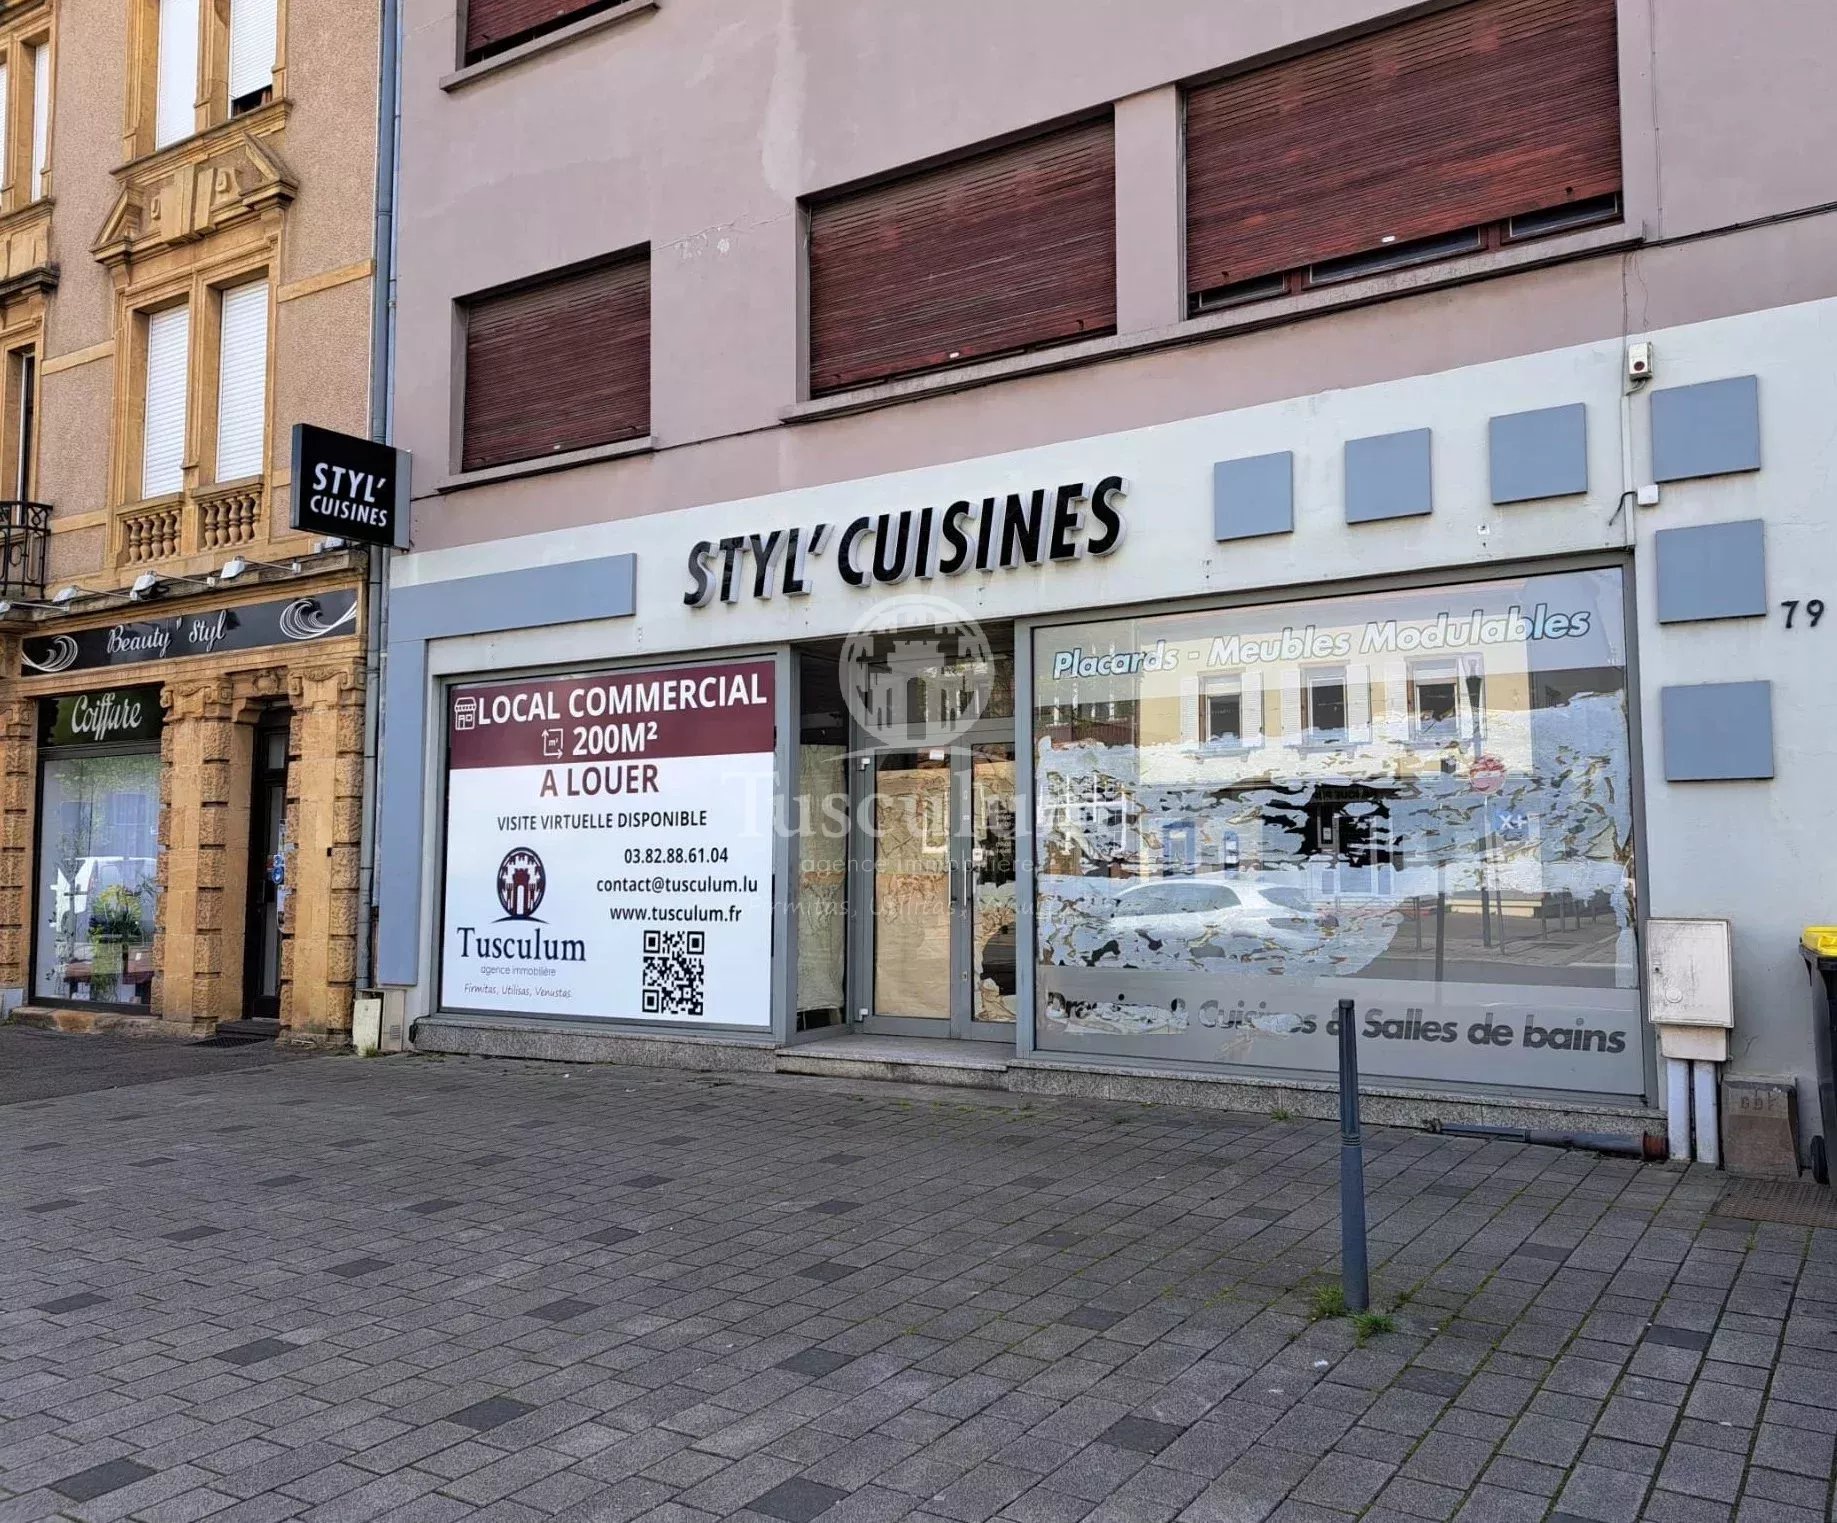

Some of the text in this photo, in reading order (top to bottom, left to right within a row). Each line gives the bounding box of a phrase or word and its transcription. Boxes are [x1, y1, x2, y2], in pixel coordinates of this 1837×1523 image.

[310, 494, 389, 528] CUISINES
[837, 475, 1128, 588] CUISINES
[188, 609, 226, 652] Styl
[1781, 599, 1825, 629] 79
[1053, 640, 1178, 680] Placards
[1207, 624, 1350, 667] Meubles
[1359, 603, 1590, 654] Modulables
[478, 673, 767, 725] LOCAL COMMERCIAL
[71, 692, 143, 741] Coiffure
[572, 721, 658, 756] 200M²
[539, 764, 659, 798] A LOUER
[497, 810, 708, 831] VISITE VIRTUELLE DISPONIBLE
[624, 848, 728, 865] 03.82.88.61.04
[596, 875, 758, 894] contact@tusculum.lu
[609, 905, 743, 923] www.tusculum.fr
[457, 927, 587, 962] Tusculum
[480, 965, 511, 977] agence
[1362, 1008, 1458, 1043] Salles
[1467, 1012, 1514, 1046] de
[1522, 1014, 1627, 1053] bains
